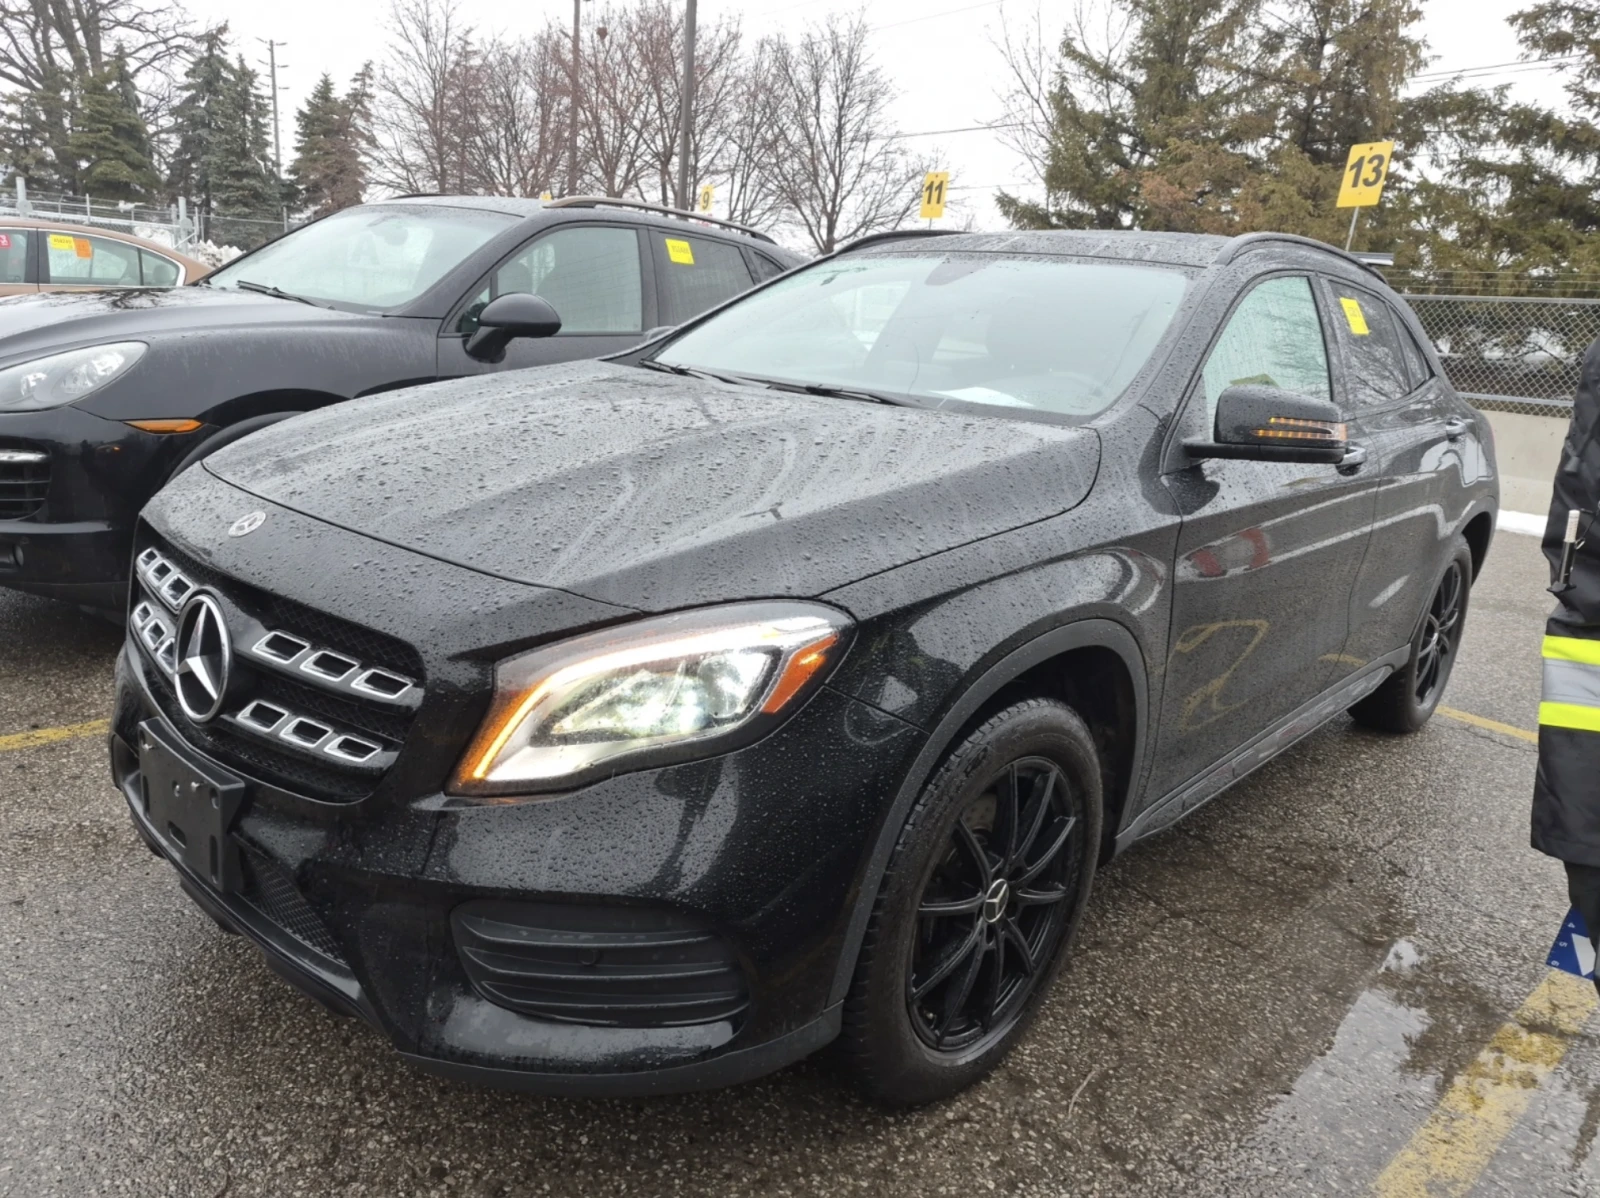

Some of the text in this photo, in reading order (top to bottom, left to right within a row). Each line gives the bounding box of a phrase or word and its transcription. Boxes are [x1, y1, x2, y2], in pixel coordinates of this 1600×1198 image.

[1349, 153, 1385, 188] 13
[702, 191, 710, 210] 9
[925, 180, 944, 204] 11
